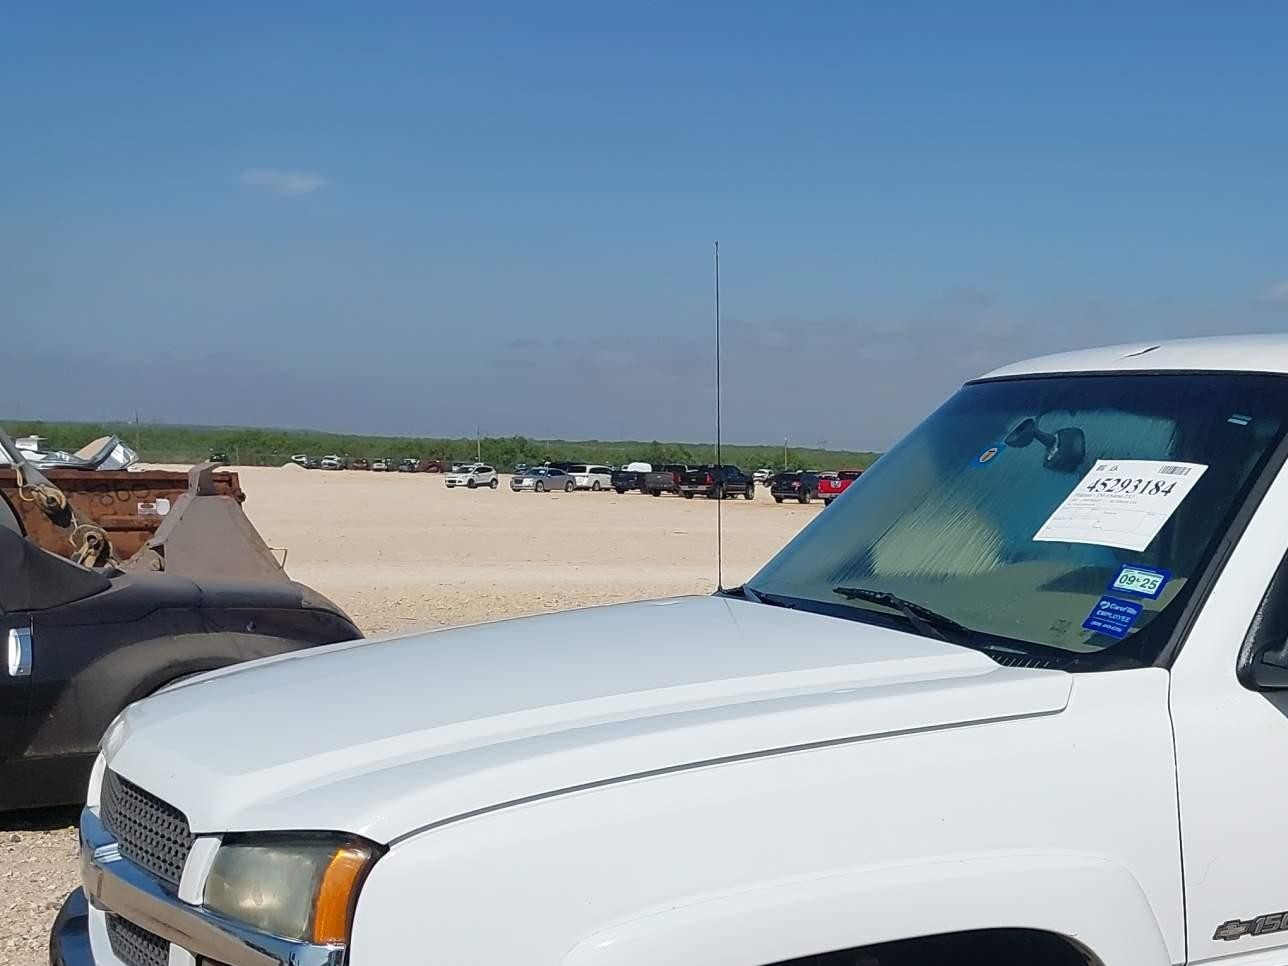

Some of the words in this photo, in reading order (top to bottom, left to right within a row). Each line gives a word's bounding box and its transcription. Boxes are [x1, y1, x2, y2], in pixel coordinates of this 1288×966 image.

[1087, 478, 1177, 496] 45293184
[1119, 574, 1136, 586] 09
[1140, 577, 1159, 590] 25
